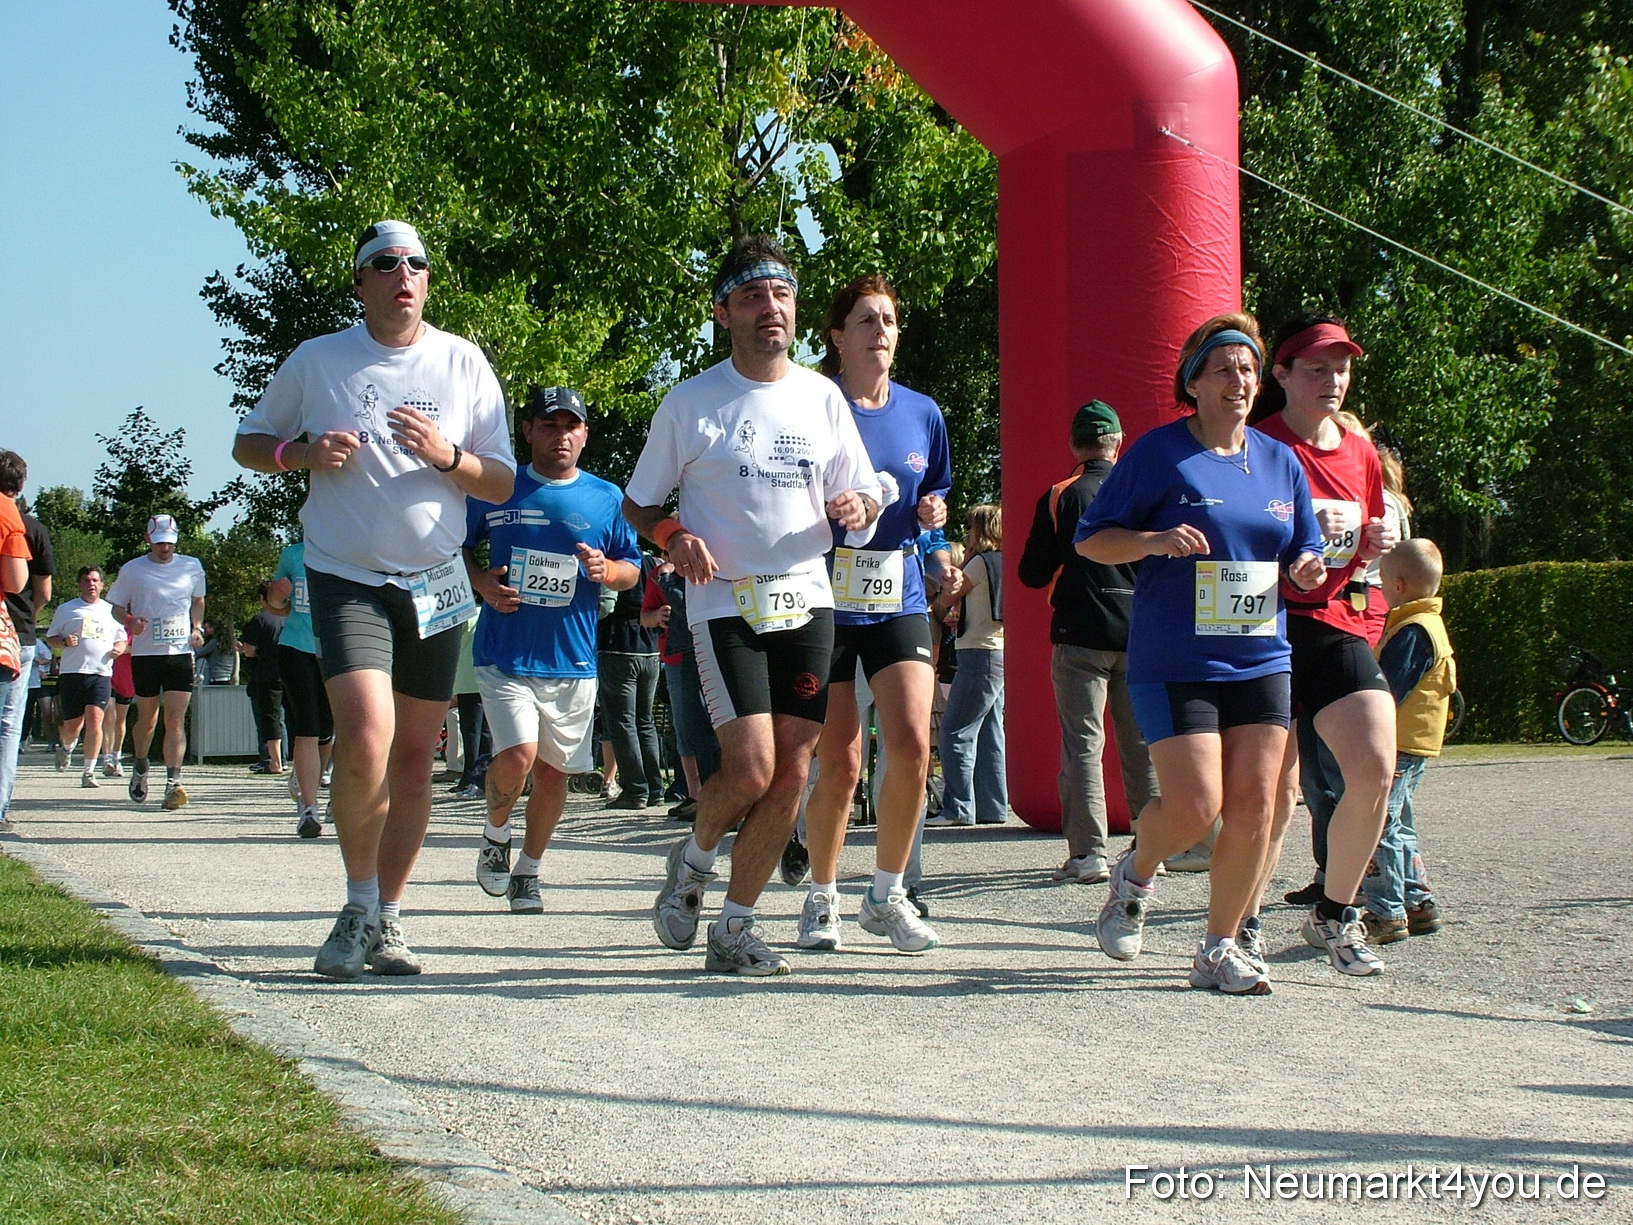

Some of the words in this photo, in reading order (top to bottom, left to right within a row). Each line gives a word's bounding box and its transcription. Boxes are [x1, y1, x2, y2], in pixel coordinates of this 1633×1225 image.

[739, 465, 754, 477] 8.
[757, 469, 812, 479] Neumarkter
[528, 554, 560, 569] Gökhan
[855, 555, 880, 568] Erika
[426, 561, 456, 582] Michael
[1221, 567, 1248, 582] Rosa
[527, 574, 571, 594] 2235
[862, 578, 893, 595] 799
[434, 581, 468, 611] 3201
[768, 591, 806, 611] 798
[1230, 594, 1267, 615] 797
[163, 628, 185, 637] 2416
